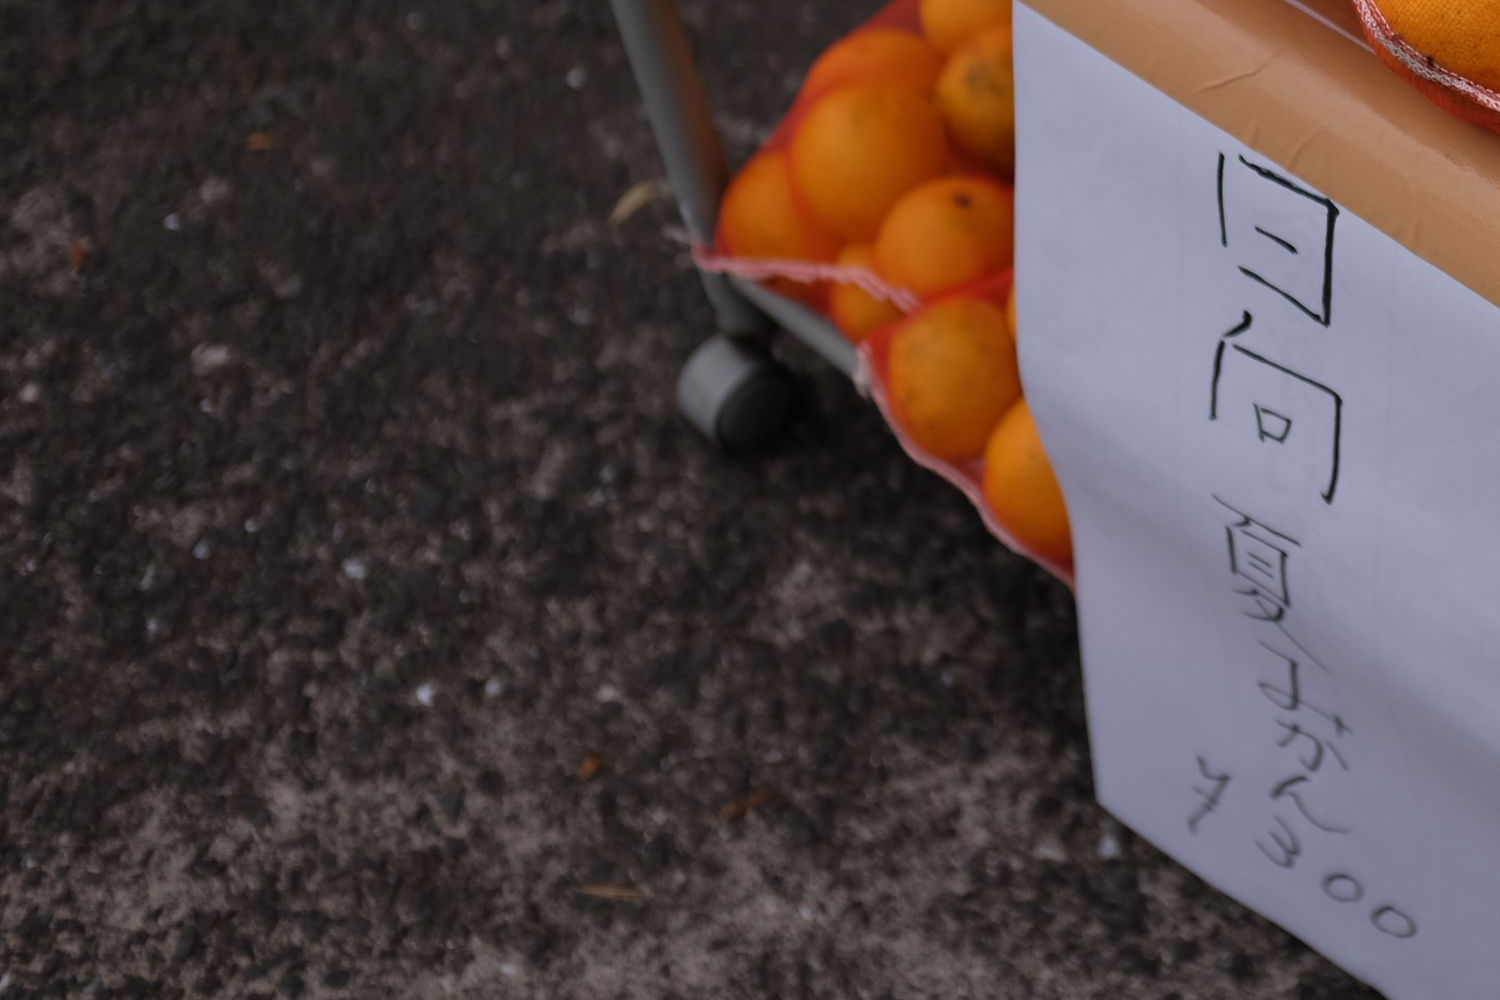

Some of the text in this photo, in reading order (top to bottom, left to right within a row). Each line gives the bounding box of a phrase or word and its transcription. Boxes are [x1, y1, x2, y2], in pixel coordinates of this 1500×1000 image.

[1211, 152, 1354, 834] 日向夏みかん
